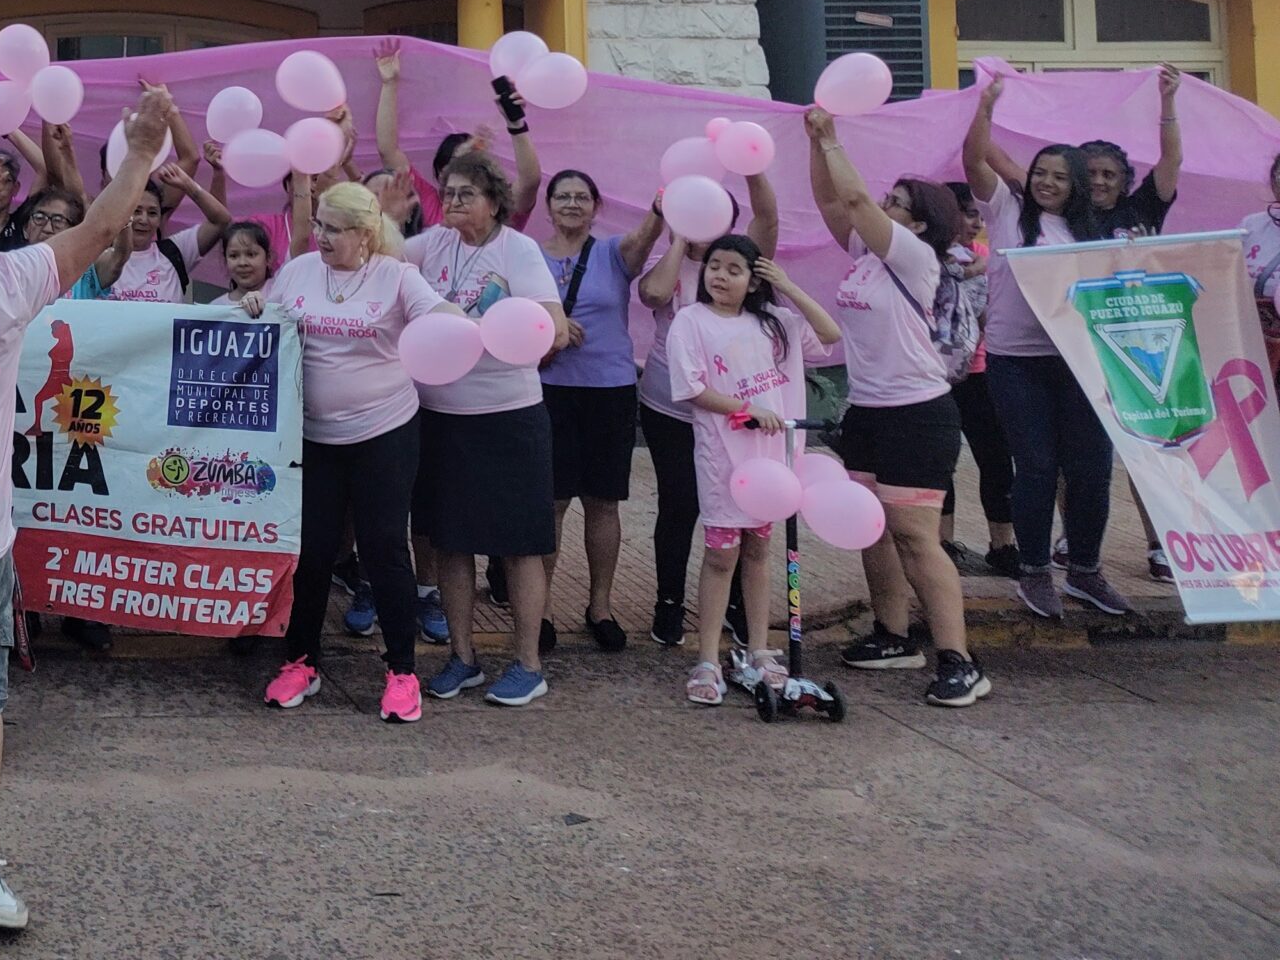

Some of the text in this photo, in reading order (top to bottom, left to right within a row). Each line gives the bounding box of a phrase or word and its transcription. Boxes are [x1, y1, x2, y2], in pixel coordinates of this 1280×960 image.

[1105, 293, 1165, 307] CIUDAD DE
[1089, 305, 1139, 320] PUERTO
[299, 324, 377, 340] MINATA ROSA
[180, 325, 273, 359] IGUAZÚ
[178, 368, 270, 384] DIRECCIÓN
[177, 385, 269, 401] MUNICIPAL DE
[70, 388, 106, 420] 12
[176, 398, 269, 414] DEPORTES
[175, 410, 268, 427] Y RECREACIÓN
[69, 420, 101, 434] AÑOS
[193, 458, 257, 486] ZUMBA
[32, 502, 278, 544] CLASES GRATUITAS
[74, 550, 177, 587] MASTER
[184, 564, 273, 594] CLASS
[47, 578, 269, 626] TRES FRONTERAS
